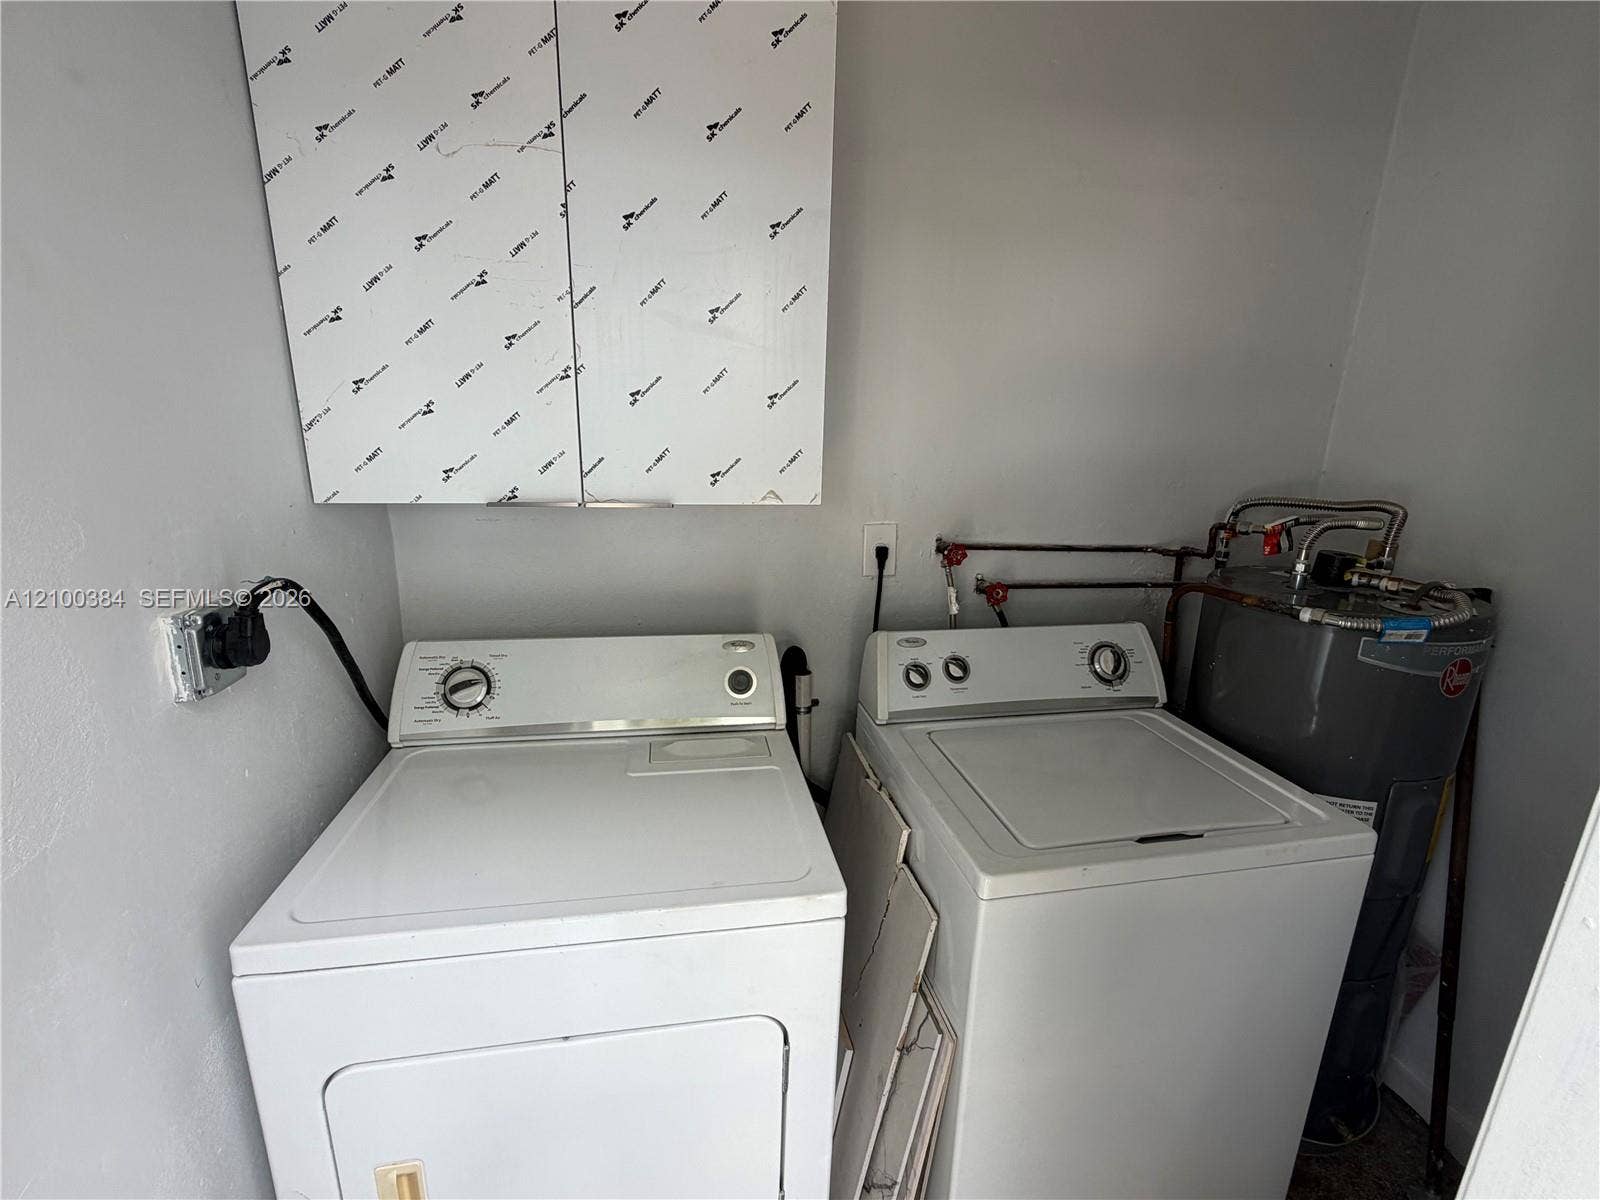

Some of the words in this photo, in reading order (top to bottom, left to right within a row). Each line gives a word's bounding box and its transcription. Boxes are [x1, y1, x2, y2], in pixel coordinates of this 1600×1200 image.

[332, 0, 348, 16] PET-G
[452, 2, 464, 14] SK
[698, 8, 712, 23] PET-G
[710, 0, 722, 11] MA
[314, 14, 334, 33] MATT
[422, 13, 450, 38] chemicals
[614, 20, 626, 32] SK
[771, 37, 782, 49] SK
[784, 13, 808, 38] chemicals
[279, 45, 292, 57] SK
[528, 42, 543, 56] PET-G
[250, 56, 278, 80] chemicals
[373, 74, 388, 88] PET-G
[386, 58, 405, 76] MATT
[470, 98, 482, 110] SK
[483, 76, 510, 100] chemicals
[633, 105, 647, 119] PET-G
[644, 88, 661, 107] MATT
[784, 119, 797, 132] PET-G
[795, 102, 812, 120] MATT
[315, 132, 327, 143] SK
[328, 108, 356, 132] chemicals
[433, 122, 448, 136] PET-G
[544, 120, 556, 132] SK
[416, 134, 436, 152] MATT
[706, 130, 718, 142] SK
[278, 155, 292, 170] PET-G
[383, 163, 394, 174] SK
[355, 173, 382, 196] chemicals
[470, 188, 484, 201] PET-G
[482, 172, 500, 190] MATT
[700, 206, 714, 220] PET-G
[711, 190, 728, 208] MATT
[308, 231, 322, 245] PET-G
[320, 216, 339, 234] MATT
[622, 220, 634, 231] SK
[414, 242, 426, 252] SK
[427, 220, 454, 242] chemicals
[525, 230, 539, 244] PET-G
[769, 229, 780, 240] SK
[509, 241, 527, 258] MATT
[378, 264, 393, 277] PET-G
[477, 269, 488, 280] SK
[362, 274, 381, 292] MATT
[450, 278, 476, 301] chemicals
[650, 278, 667, 297] MATT
[782, 300, 794, 313] PET-G
[792, 285, 808, 302] MATT
[331, 306, 342, 316] SK
[303, 314, 330, 336] chemicals
[708, 314, 718, 325] SK
[405, 332, 419, 346] PET-G
[416, 318, 435, 336] MATT
[504, 340, 515, 351] SK
[516, 320, 541, 342] chemicals
[471, 362, 484, 374] PET-G
[562, 364, 572, 374] SK
[712, 368, 728, 384] MATT
[352, 385, 364, 395] SK
[364, 364, 389, 386] chemicals
[455, 372, 472, 388] MATT
[536, 373, 560, 395] chemicals
[424, 400, 434, 410] SK
[630, 397, 639, 407] SK
[767, 400, 776, 410] SK
[398, 408, 422, 430] chemicals
[492, 424, 506, 437] PET-G
[504, 411, 521, 428] MATT
[354, 460, 368, 473] PET-G
[366, 447, 384, 463] MATT
[553, 450, 566, 462] PET-G
[655, 448, 670, 464] MATT
[789, 448, 804, 464] MATT
[442, 474, 452, 484] SK
[453, 454, 478, 474] chemicals
[538, 460, 554, 475] MATT
[510, 486, 520, 495] SK
[710, 478, 720, 487] SK
